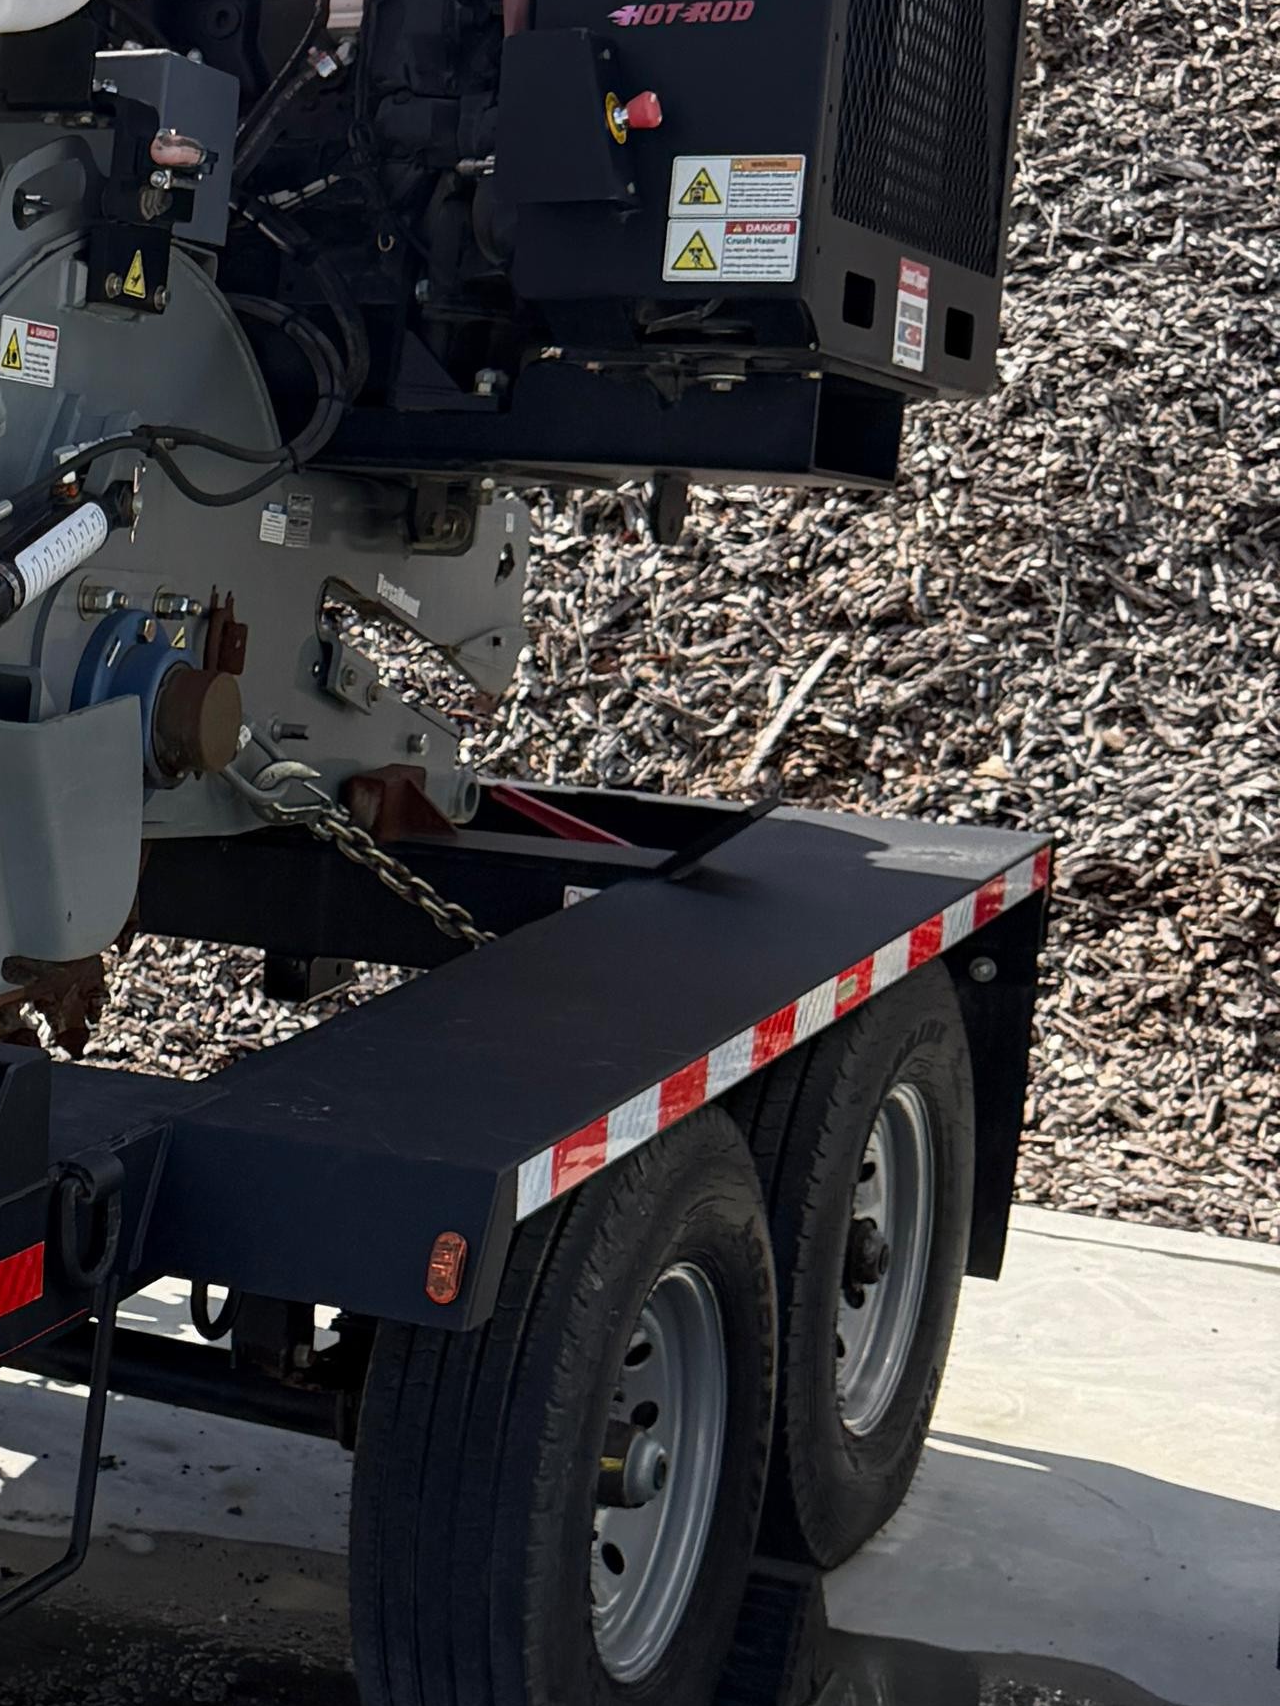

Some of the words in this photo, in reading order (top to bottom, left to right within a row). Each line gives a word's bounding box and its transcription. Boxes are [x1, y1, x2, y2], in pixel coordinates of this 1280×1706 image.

[610, 2, 685, 26] HOT
[683, 0, 754, 23] ROD
[746, 223, 790, 233] DANGER
[726, 236, 752, 245] Crush
[754, 236, 787, 244] Hazard
